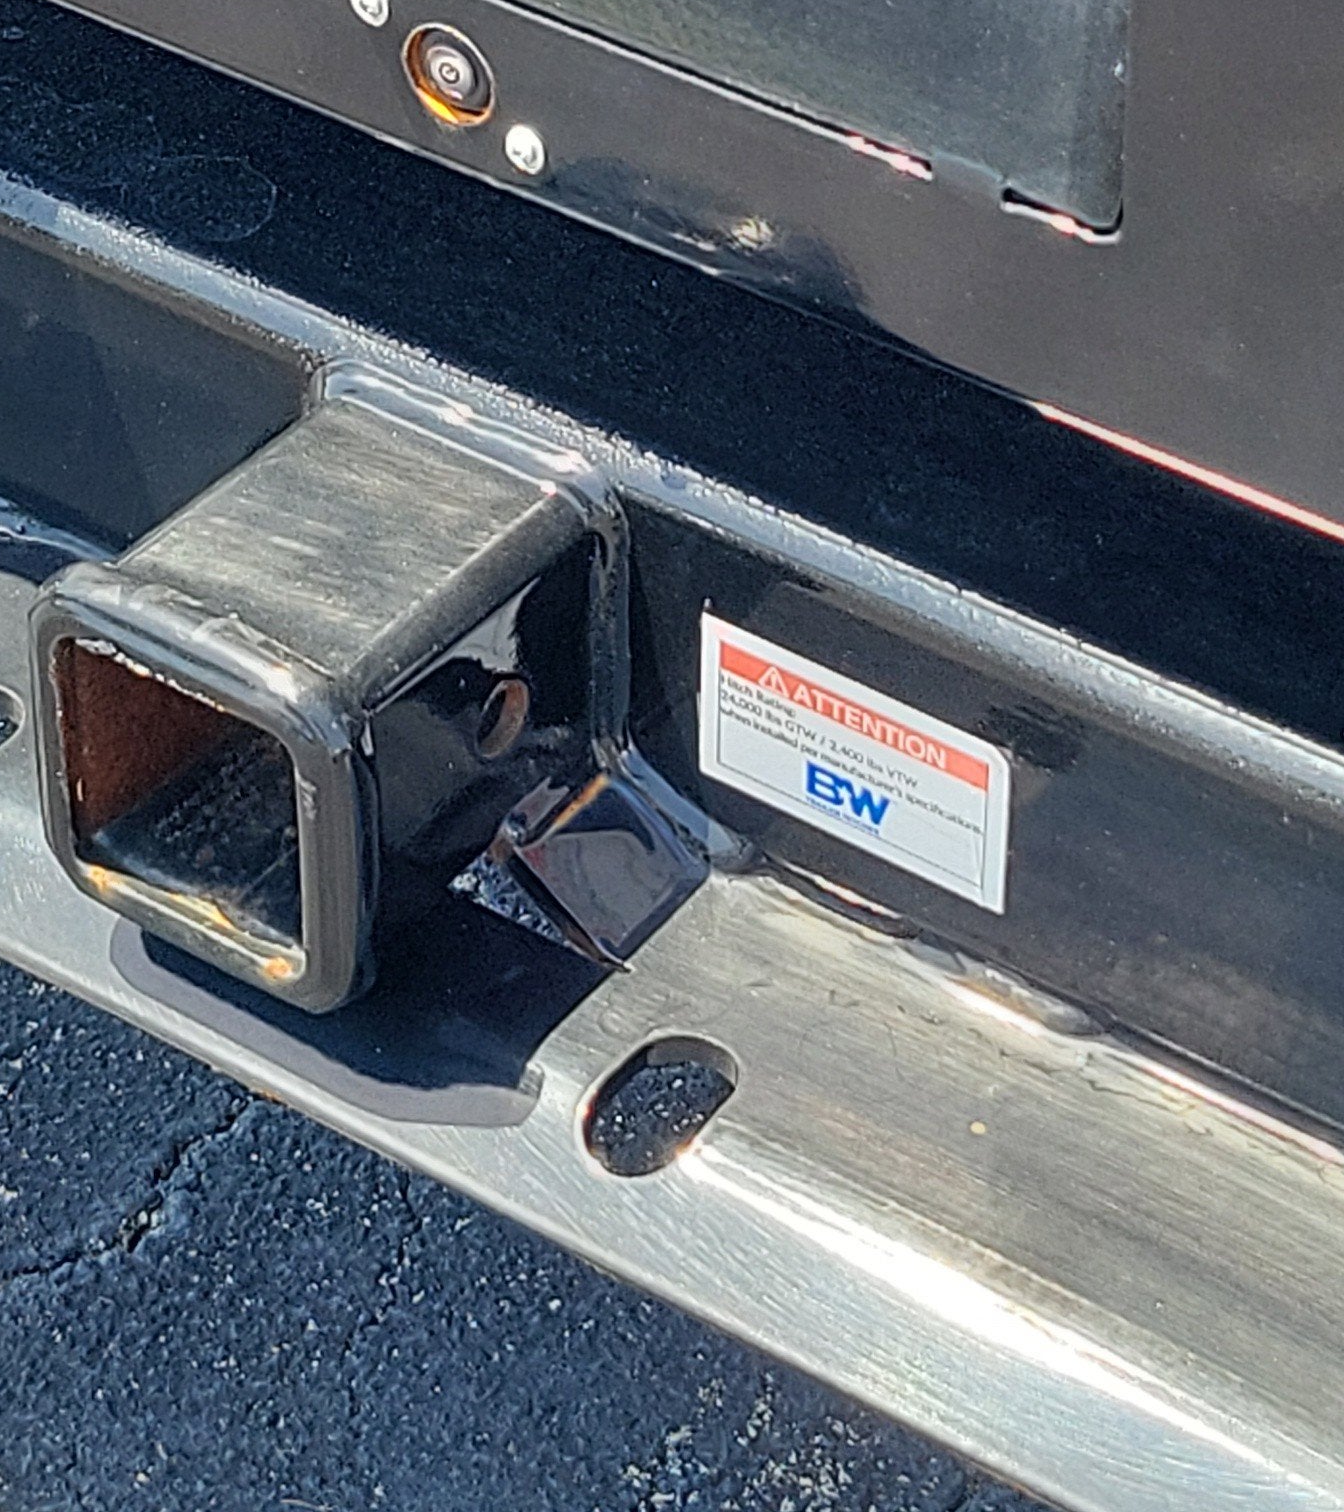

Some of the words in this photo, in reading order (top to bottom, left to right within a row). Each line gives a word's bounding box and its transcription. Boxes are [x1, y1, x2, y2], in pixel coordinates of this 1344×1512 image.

[785, 719, 818, 740] GTW
[887, 766, 918, 788] VTW
[793, 683, 946, 769] ATTENTION
